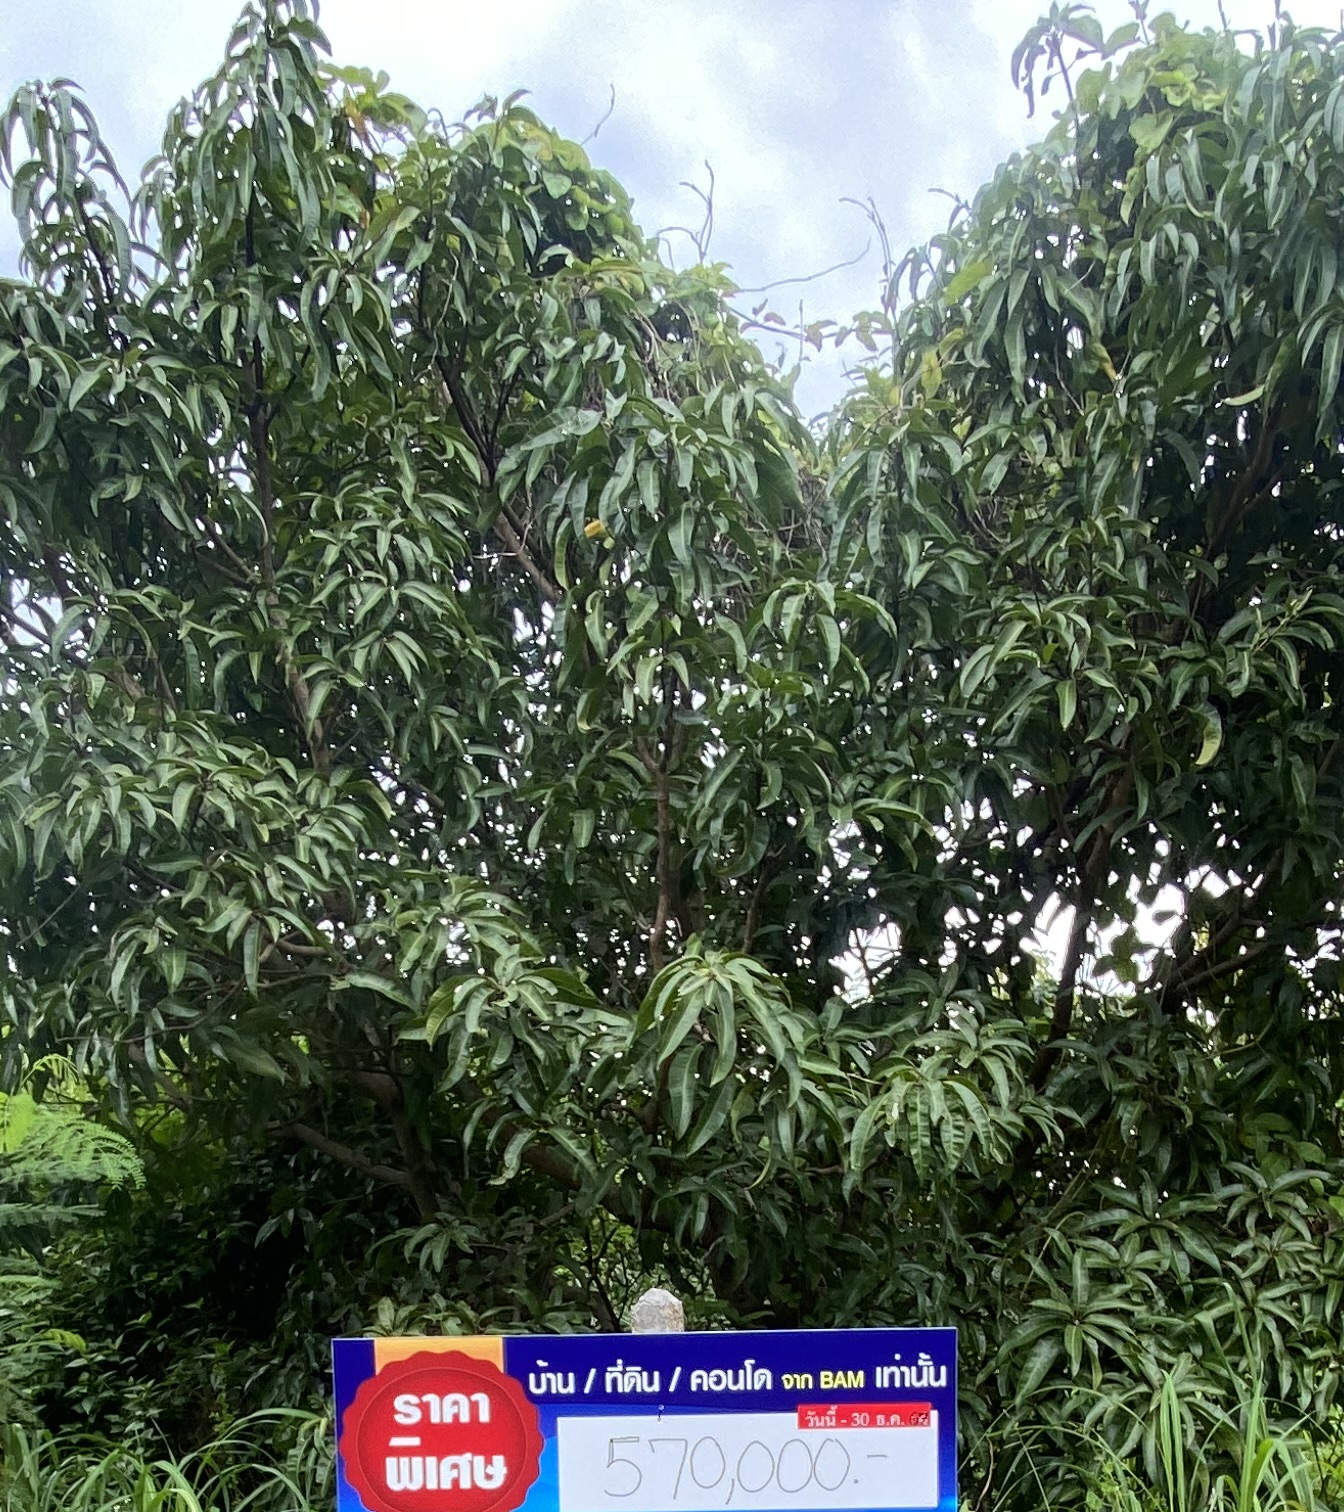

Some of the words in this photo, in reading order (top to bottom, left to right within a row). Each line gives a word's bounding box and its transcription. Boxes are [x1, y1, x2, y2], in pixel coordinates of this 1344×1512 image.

[528, 1360, 574, 1394] บ้าน
[584, 1368, 596, 1394] /
[605, 1359, 660, 1393] ที่ดิน
[669, 1366, 682, 1392] /
[690, 1359, 772, 1391] คอนโด
[782, 1374, 812, 1390] จาก
[820, 1370, 864, 1389] BAM
[875, 1353, 947, 1388] เท่านั้น
[393, 1392, 491, 1425] ราคา
[805, 1405, 837, 1427] วันนี้
[851, 1412, 869, 1427] 30
[385, 1436, 507, 1491] พิเศษ
